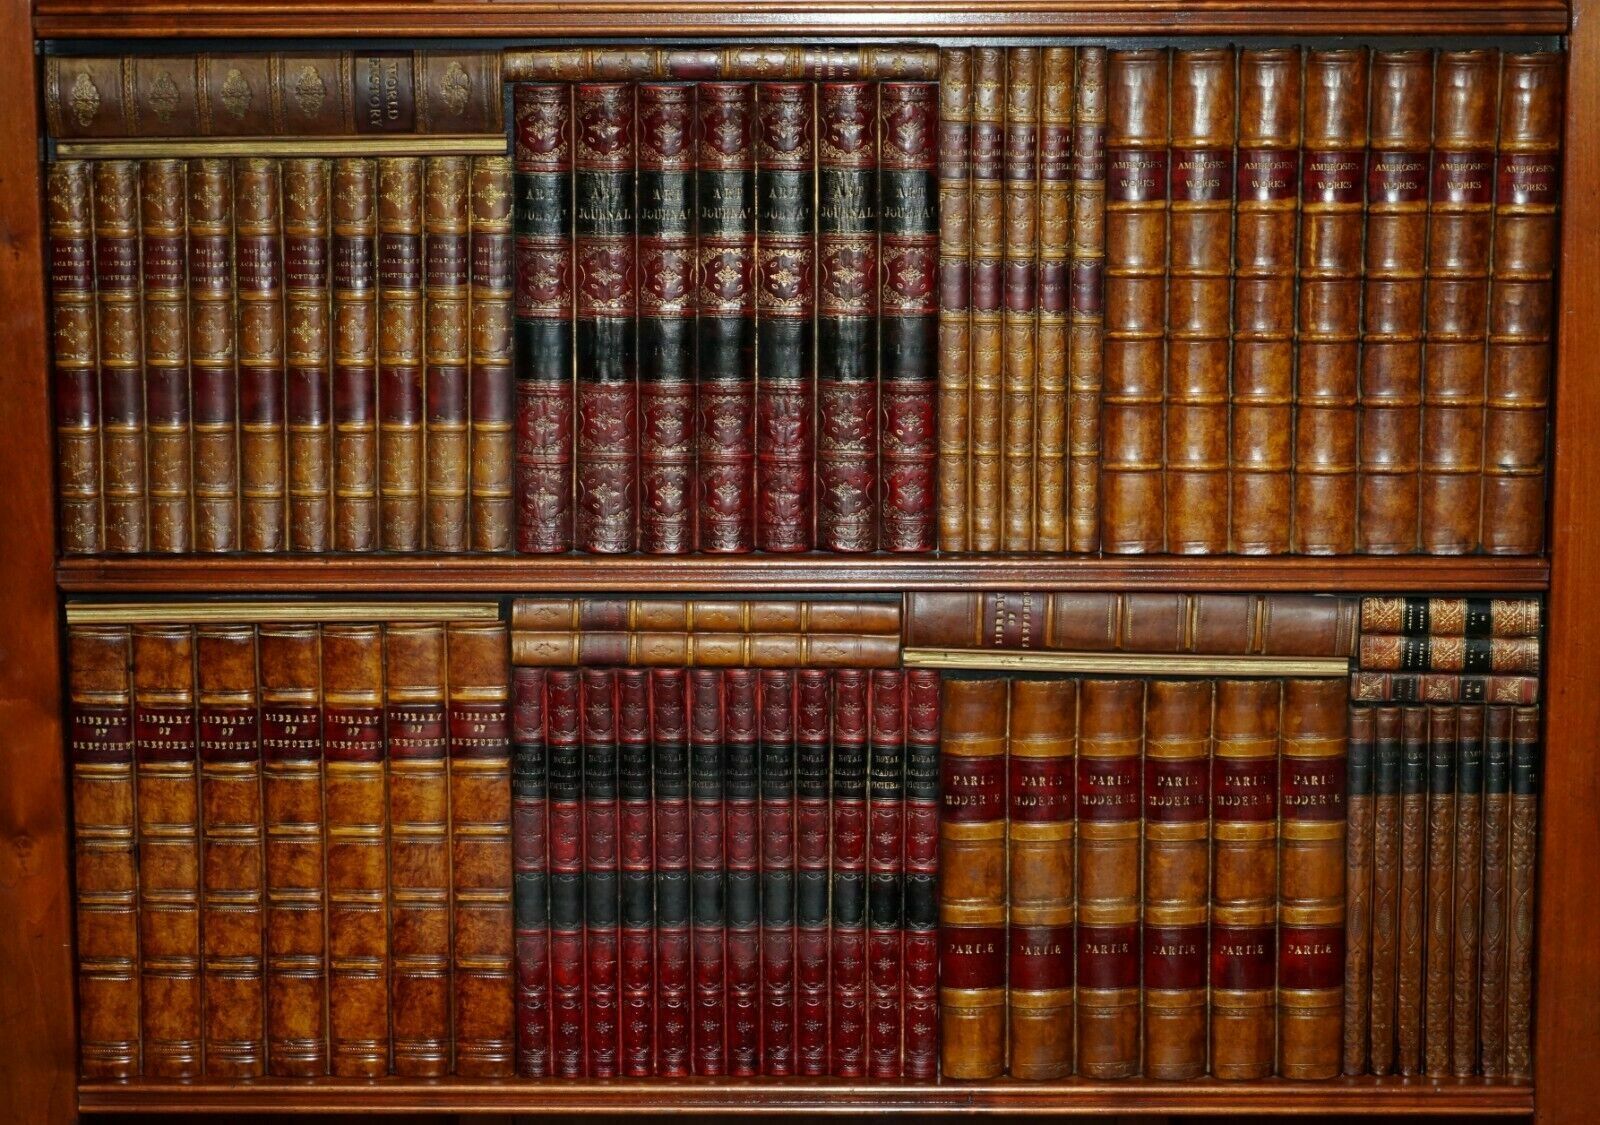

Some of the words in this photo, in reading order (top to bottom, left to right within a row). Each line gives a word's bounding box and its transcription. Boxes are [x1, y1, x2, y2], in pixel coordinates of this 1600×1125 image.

[368, 57, 381, 127] HISTORY
[385, 62, 398, 120] WORLD
[1120, 179, 1154, 188] WORKS
[1186, 179, 1219, 188] WORKS
[1252, 180, 1286, 188] WORKS
[1318, 181, 1352, 189] WORKS
[1383, 182, 1417, 190] WORKS
[1446, 181, 1481, 189] WORKS
[526, 189, 554, 200] ART
[591, 188, 620, 199] ART
[653, 189, 682, 200] ART
[713, 188, 742, 198] ART
[769, 187, 798, 198] ART
[835, 187, 863, 198] ART
[897, 187, 925, 198] ART
[995, 593, 1005, 645] LIBRARY
[76, 717, 126, 725] LIBRARY
[139, 715, 190, 724] LIBRARY
[203, 716, 253, 724] LIBRARY
[266, 714, 317, 722] LIBRARY
[328, 716, 379, 724] LIBRARY
[390, 712, 442, 722] LIBRARY
[454, 712, 505, 721] LIBRARY
[96, 728, 107, 736] OF
[159, 727, 170, 735] OF
[286, 726, 297, 734] OF
[946, 794, 999, 805] MODERE
[1015, 796, 1067, 805] MODERE
[1082, 793, 1136, 805] MODERE
[1150, 795, 1204, 805] MODERE
[1218, 794, 1272, 805] MODERE
[1286, 794, 1340, 805] MODERE
[950, 944, 994, 954] PARTE
